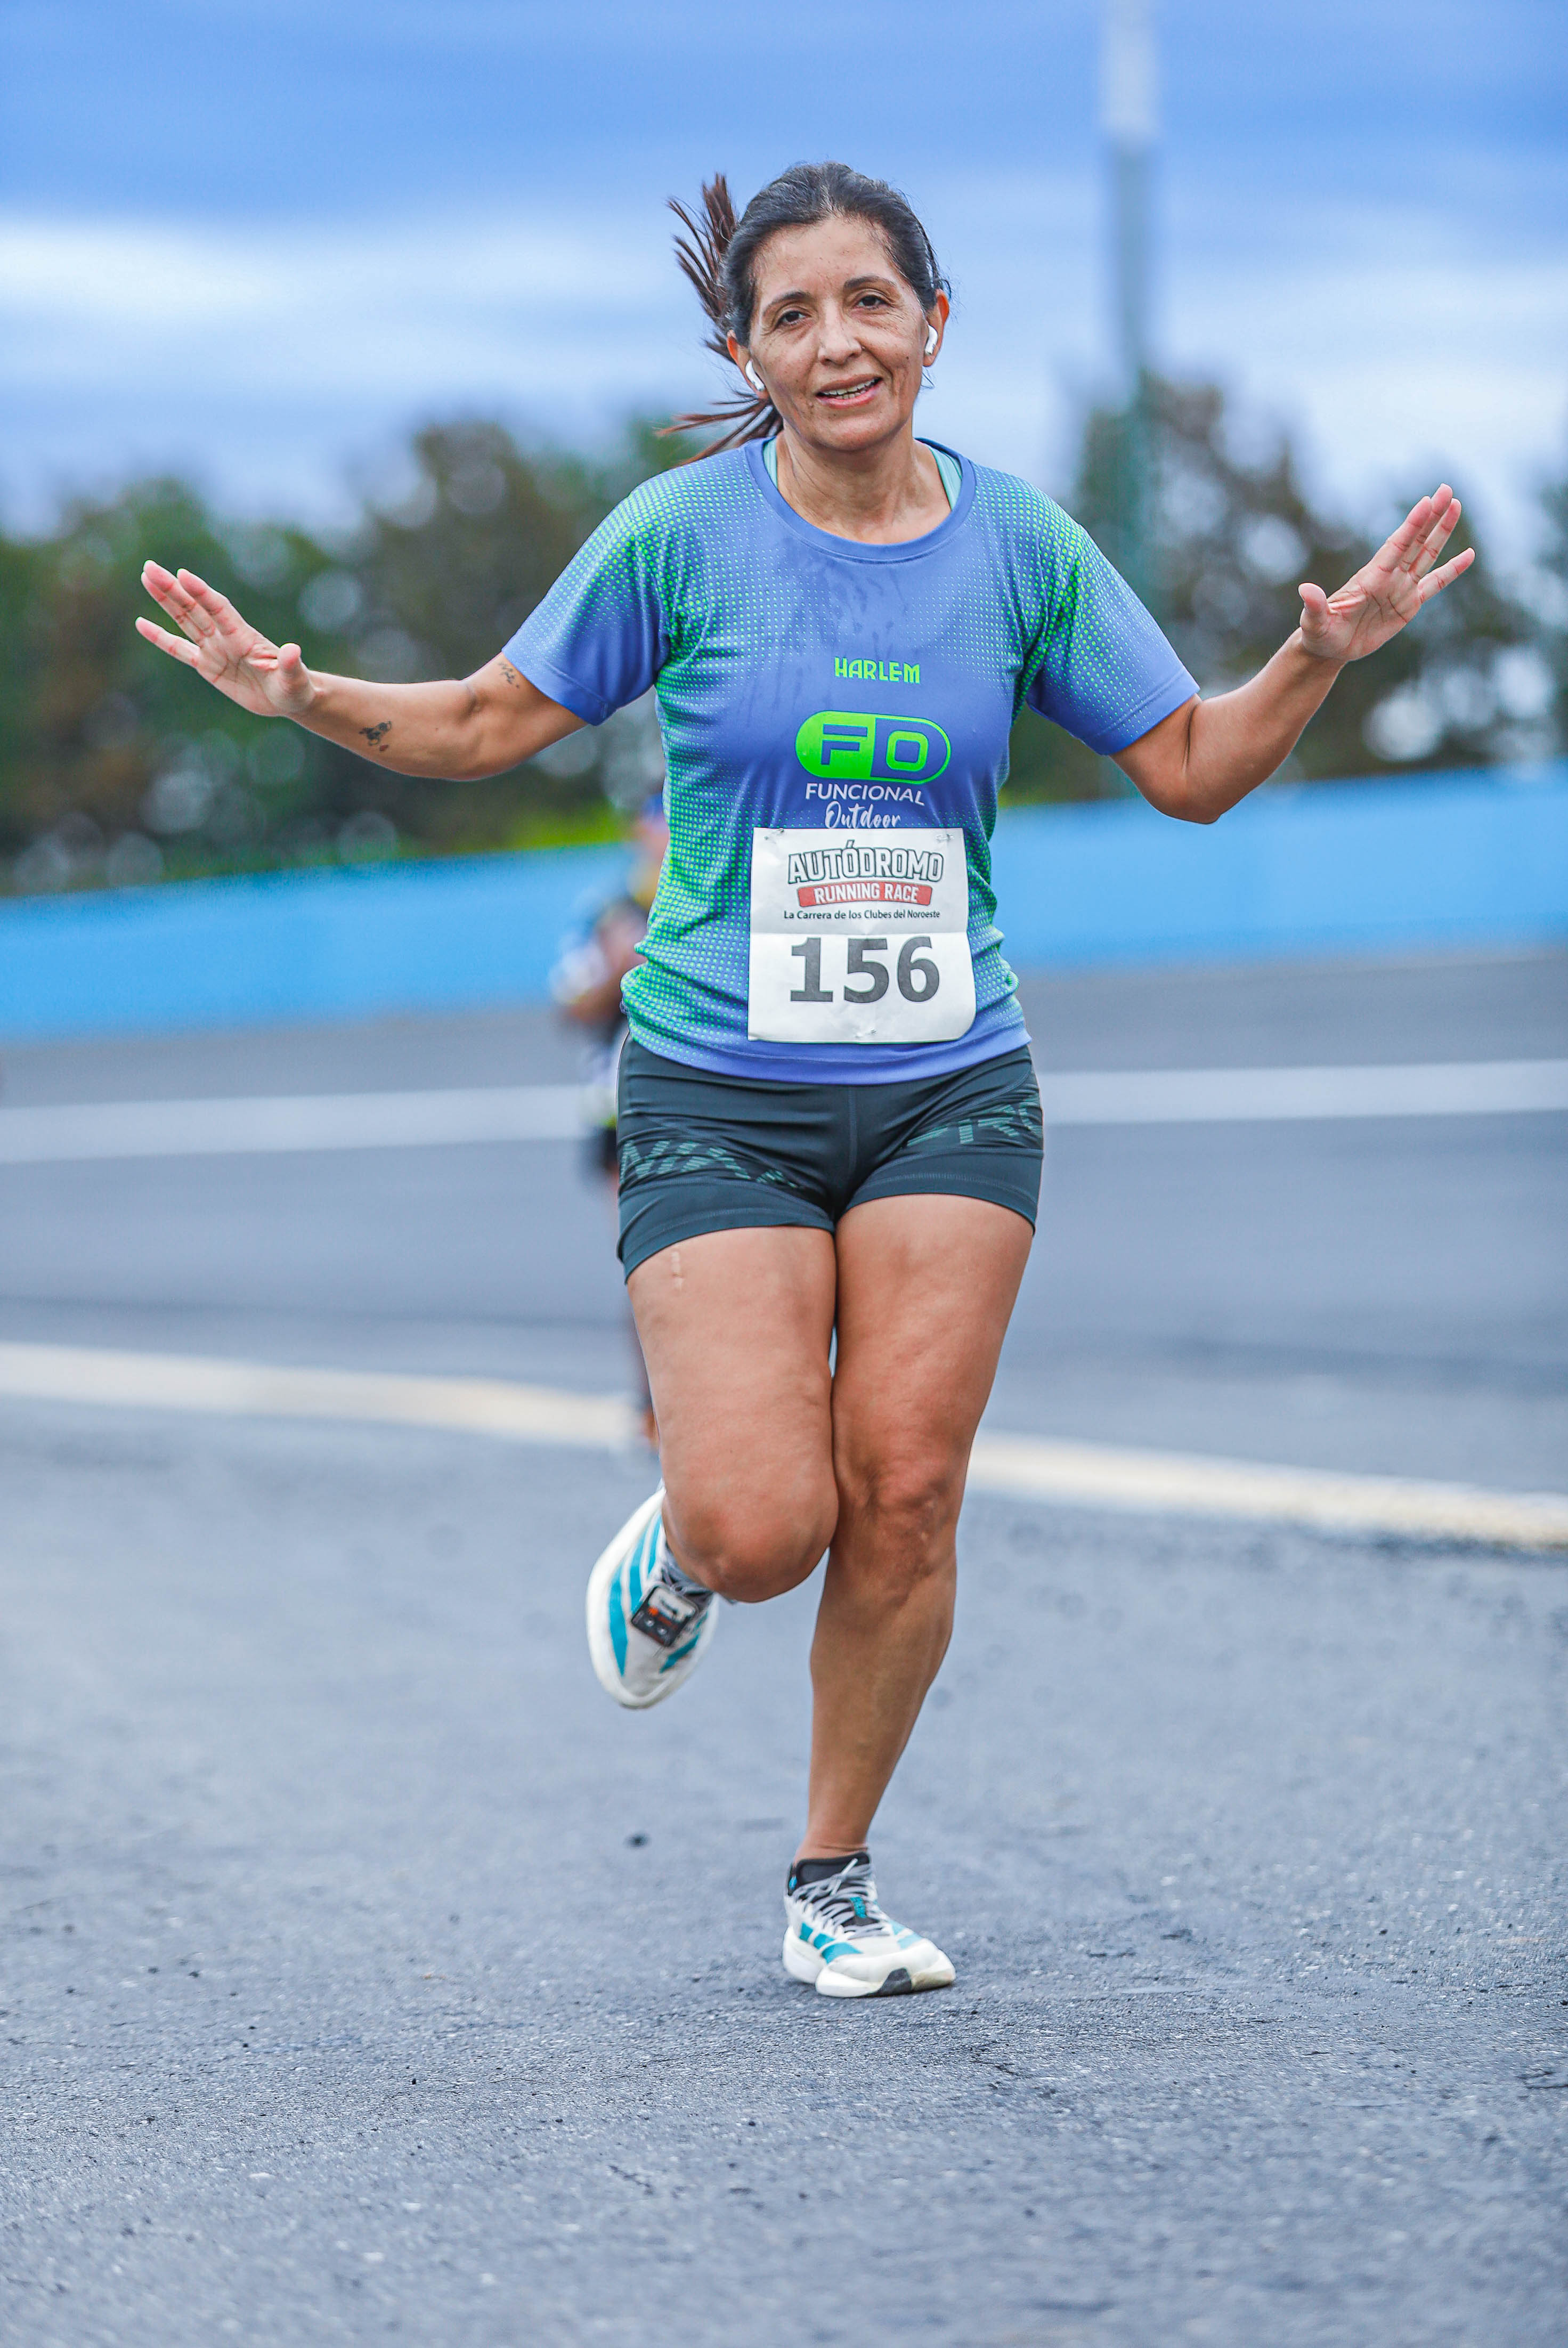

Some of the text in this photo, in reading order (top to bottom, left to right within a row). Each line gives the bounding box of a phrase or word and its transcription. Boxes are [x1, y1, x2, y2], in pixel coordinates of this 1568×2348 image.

[834, 656, 921, 684] HARLEM
[805, 783, 925, 806] FUNCIONAL
[824, 801, 901, 828] Outdoor
[787, 839, 944, 884] AUTÓDROMO
[814, 883, 920, 905] RUNNING RACE
[784, 909, 940, 919] La Carrera de los Clubes del Noroeste
[790, 936, 940, 1003] 156
